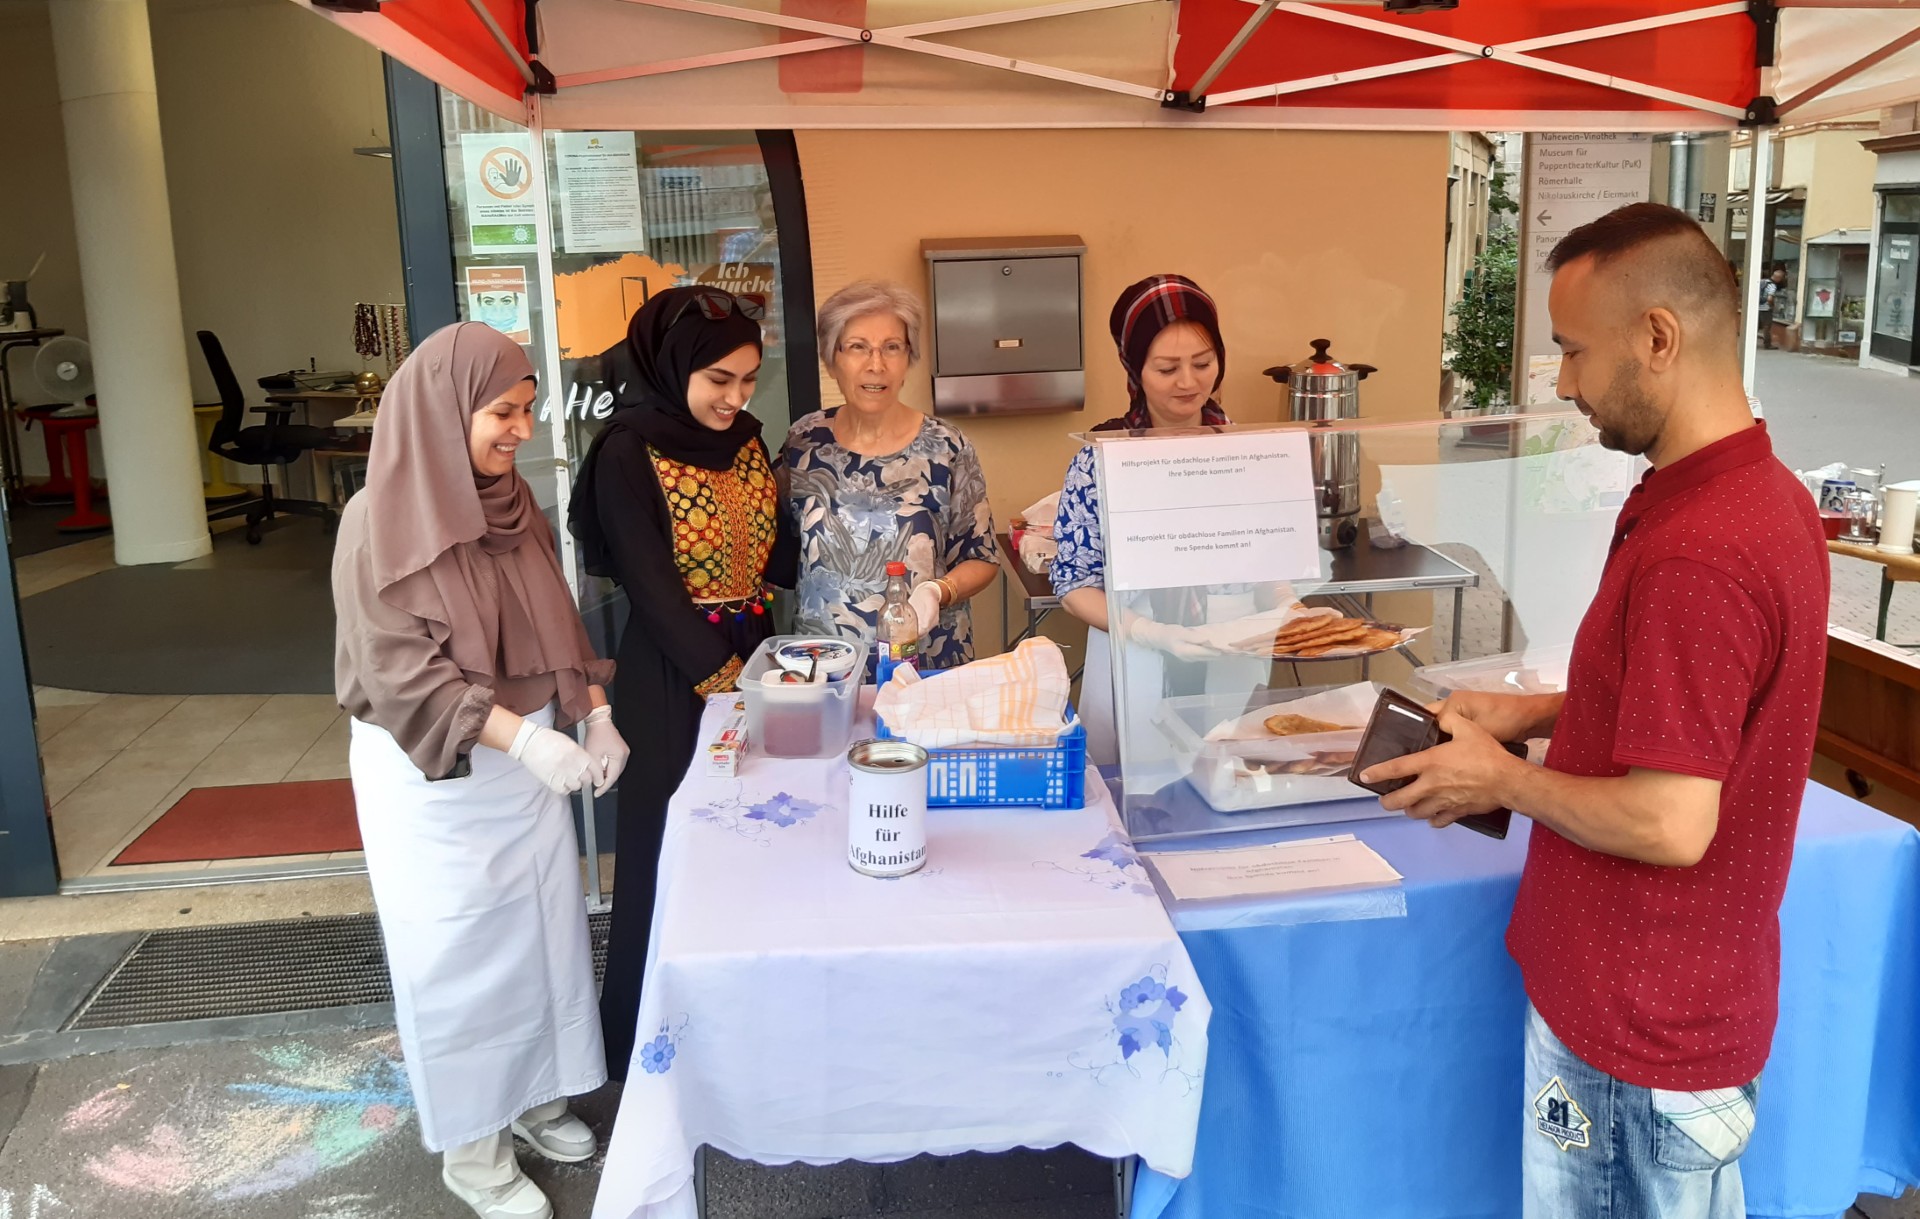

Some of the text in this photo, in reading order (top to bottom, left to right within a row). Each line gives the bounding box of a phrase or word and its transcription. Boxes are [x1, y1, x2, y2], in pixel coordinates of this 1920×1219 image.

[1541, 132, 1617, 141] Nahewein-Vinothek
[1540, 148, 1588, 157] Museum für
[1539, 159, 1642, 171] PuppentheaterKultur (PuK)
[1538, 177, 1583, 185] Römerhalle
[1538, 191, 1596, 200] Nikolauskirche
[1603, 191, 1639, 199] Eiermarkt
[717, 262, 750, 279] Ich
[1121, 459, 1160, 468] Hilfsprojekt
[1172, 456, 1210, 465] obdachlose
[1211, 454, 1240, 463] Familien
[1241, 453, 1248, 461] in
[1168, 466, 1246, 478] Ihre Spende kommt an!
[1126, 534, 1166, 543] Hilfsprojekt
[1178, 531, 1216, 540] obdachlose
[1217, 529, 1246, 538] Familien
[1189, 544, 1214, 552] Spende
[1215, 542, 1239, 550] kommt
[1240, 540, 1251, 548] an!
[869, 803, 909, 818] Hilfe
[875, 828, 901, 842] für
[1547, 1097, 1569, 1129] 21
